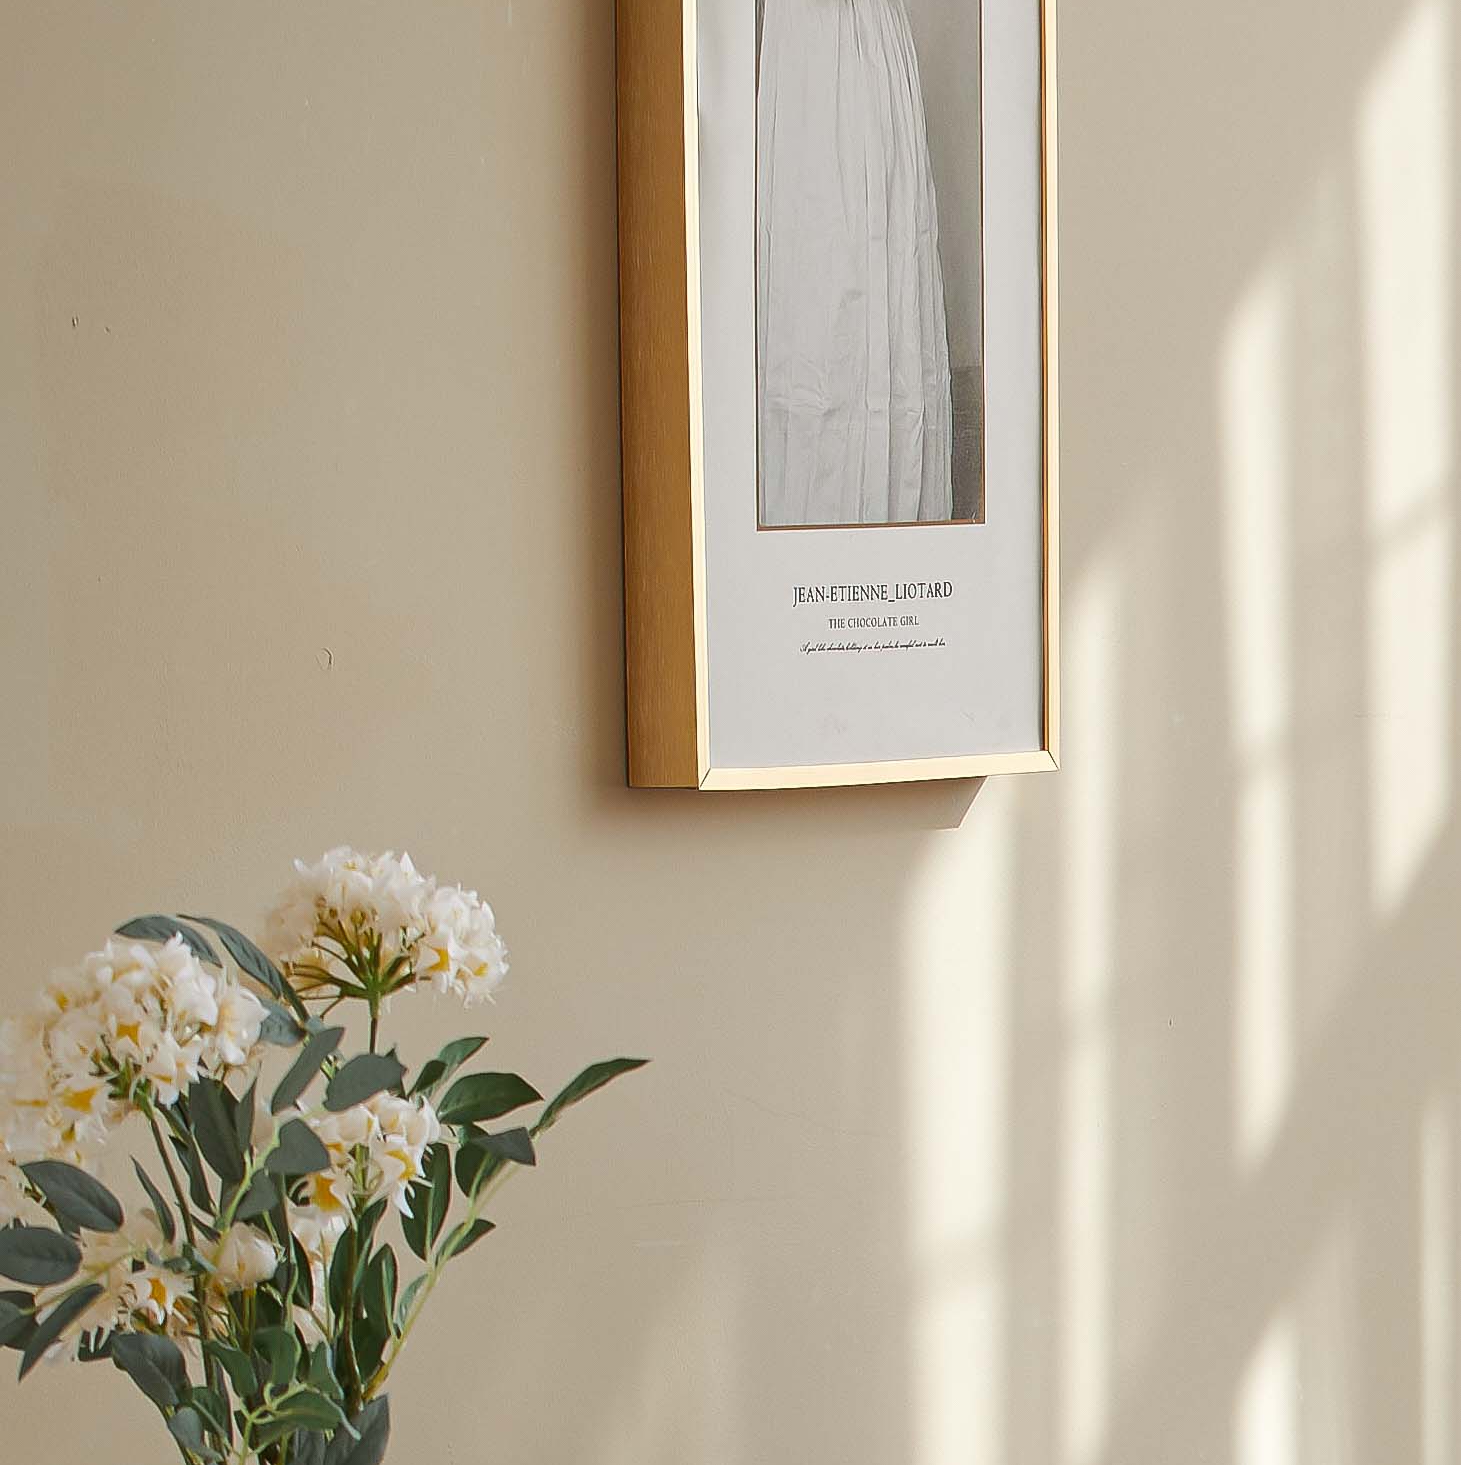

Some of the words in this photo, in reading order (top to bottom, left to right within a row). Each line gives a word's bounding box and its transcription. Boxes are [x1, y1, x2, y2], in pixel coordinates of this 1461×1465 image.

[793, 581, 954, 608] JEAN-ETIENNE_LIOTARD
[828, 618, 846, 630] THE
[847, 616, 898, 629] CHOCOLATE
[900, 615, 920, 627] GIRL
